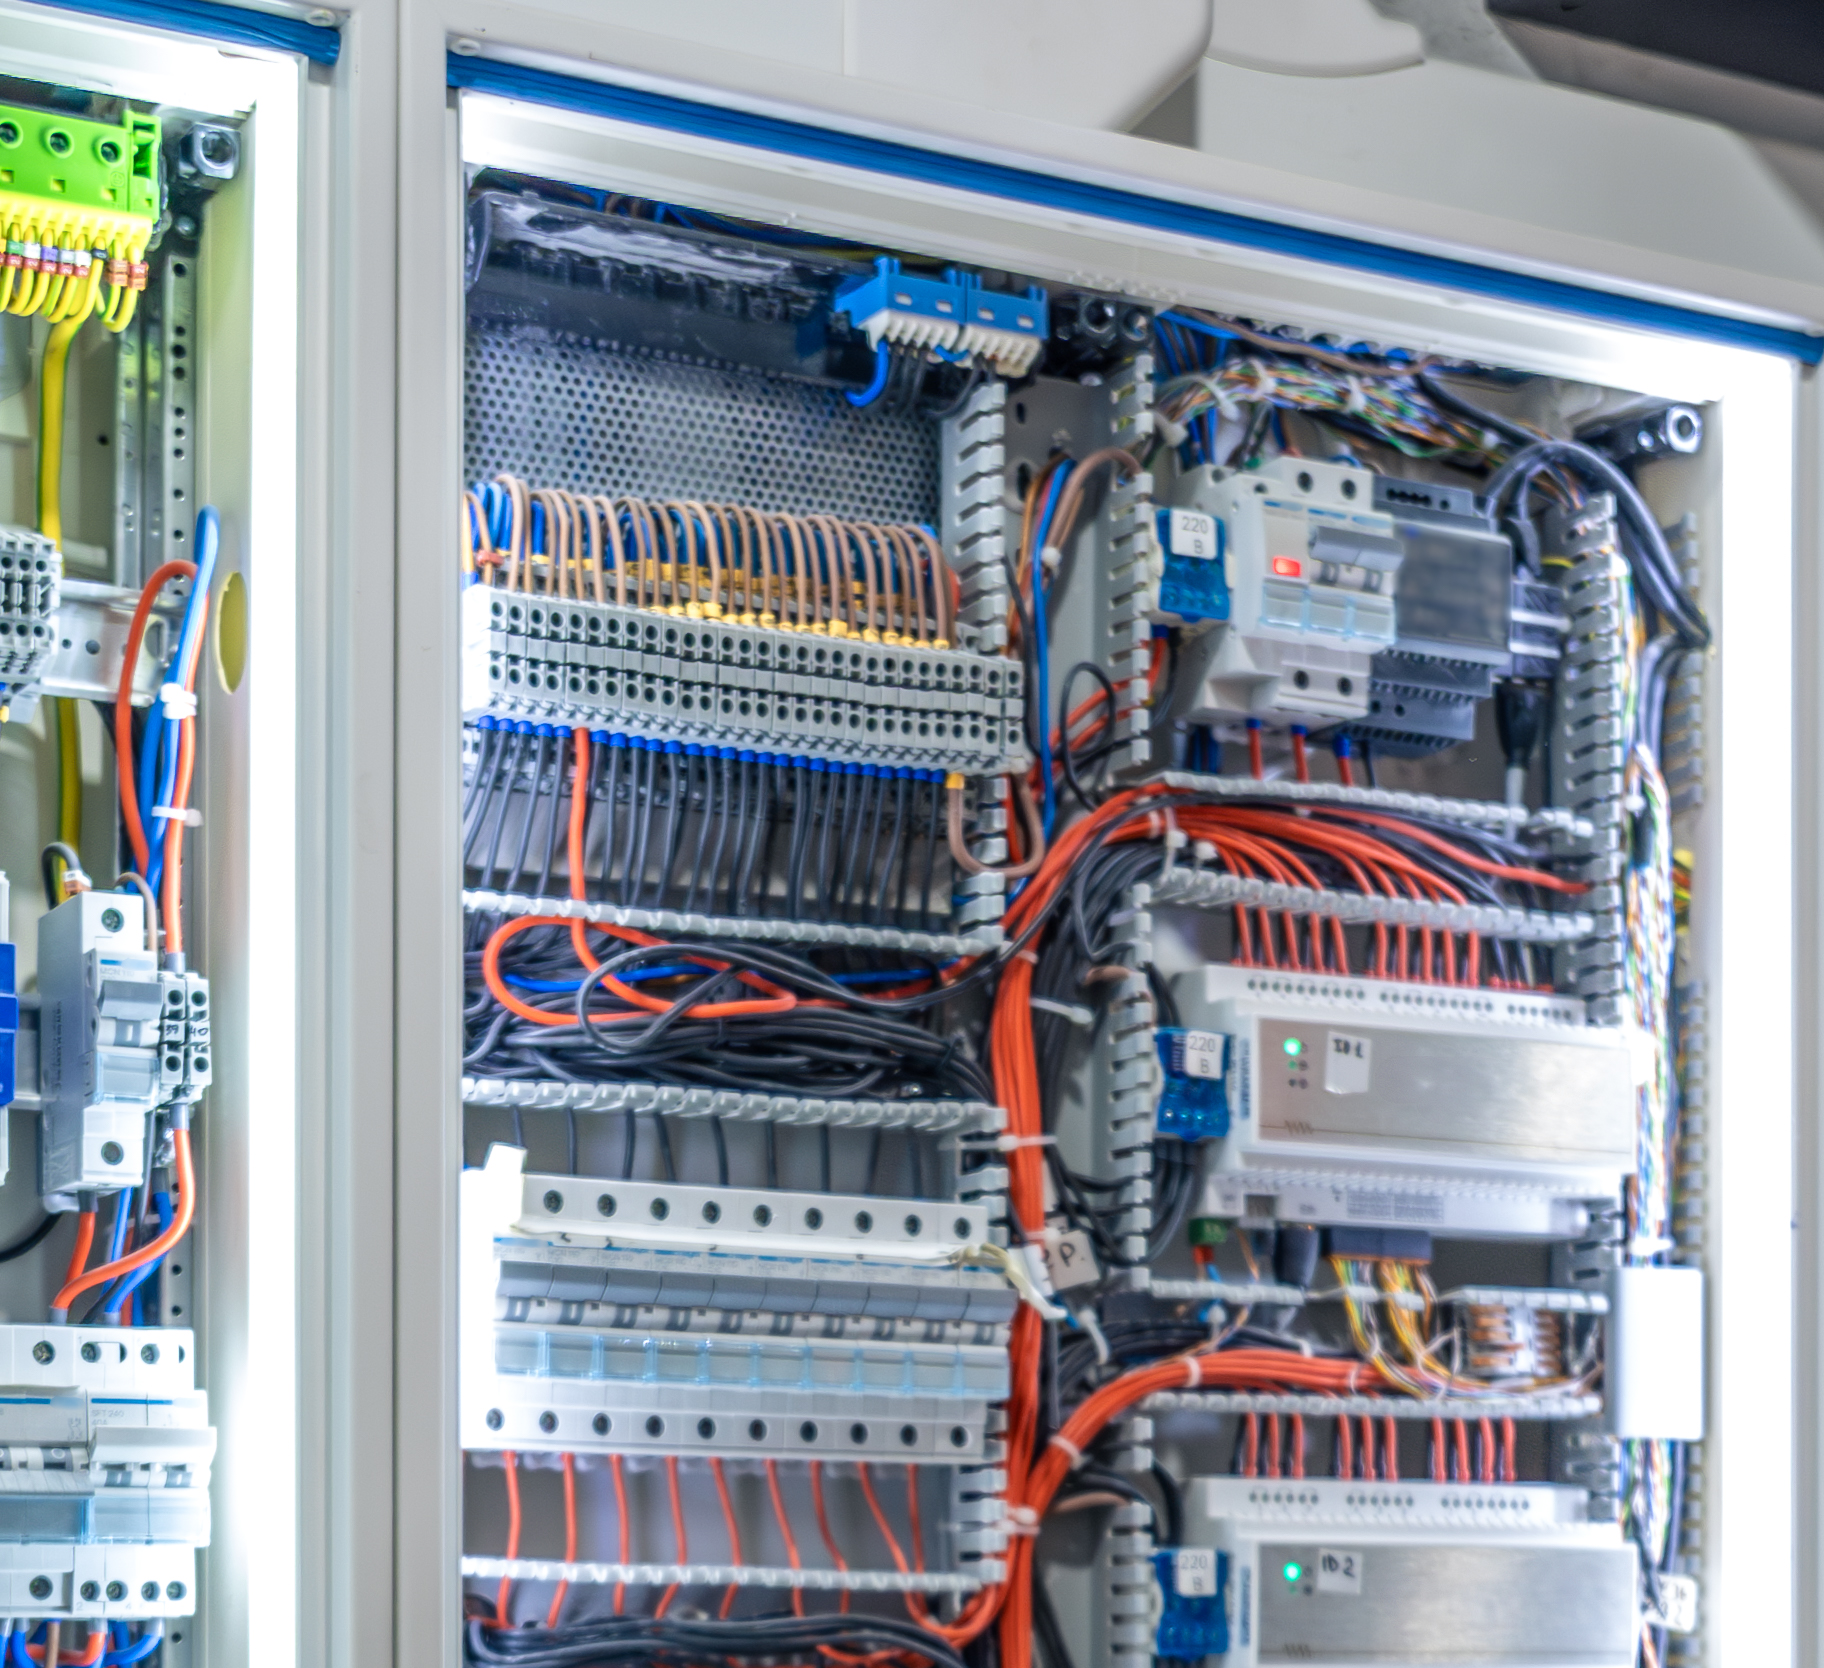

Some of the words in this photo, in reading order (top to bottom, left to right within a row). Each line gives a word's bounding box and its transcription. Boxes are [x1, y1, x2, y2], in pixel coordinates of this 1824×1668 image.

[1182, 515, 1208, 534] 220
[165, 1025, 179, 1036] 39
[1188, 1035, 1216, 1052] 220
[1180, 1554, 1208, 1570] 220
[1342, 1556, 1355, 1579] 2
